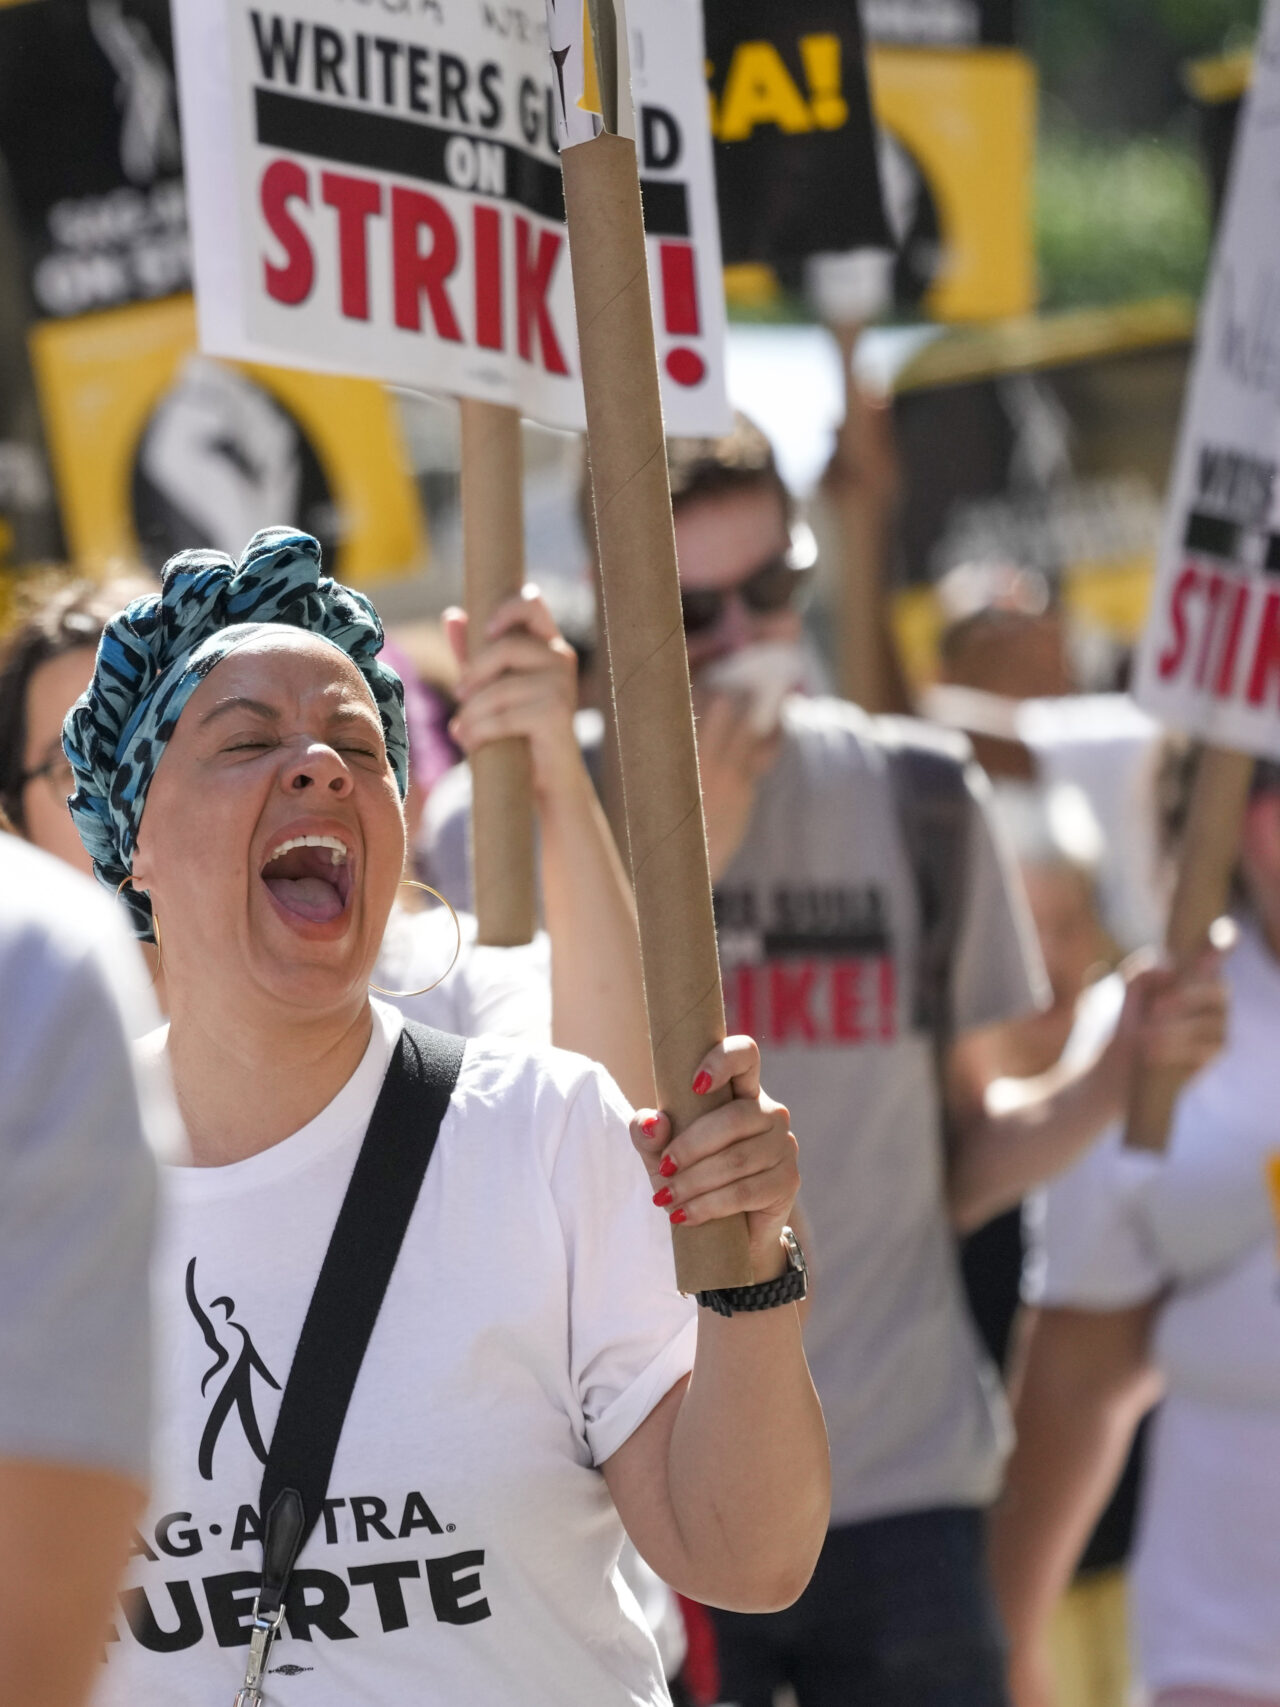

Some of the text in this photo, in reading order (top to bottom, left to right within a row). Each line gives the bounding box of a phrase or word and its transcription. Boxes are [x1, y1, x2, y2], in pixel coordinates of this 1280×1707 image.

[251, 11, 683, 172] WRITERS GUD
[444, 134, 507, 198] ON
[260, 158, 706, 387] STRIK!
[106, 1549, 492, 1656] UERTE
